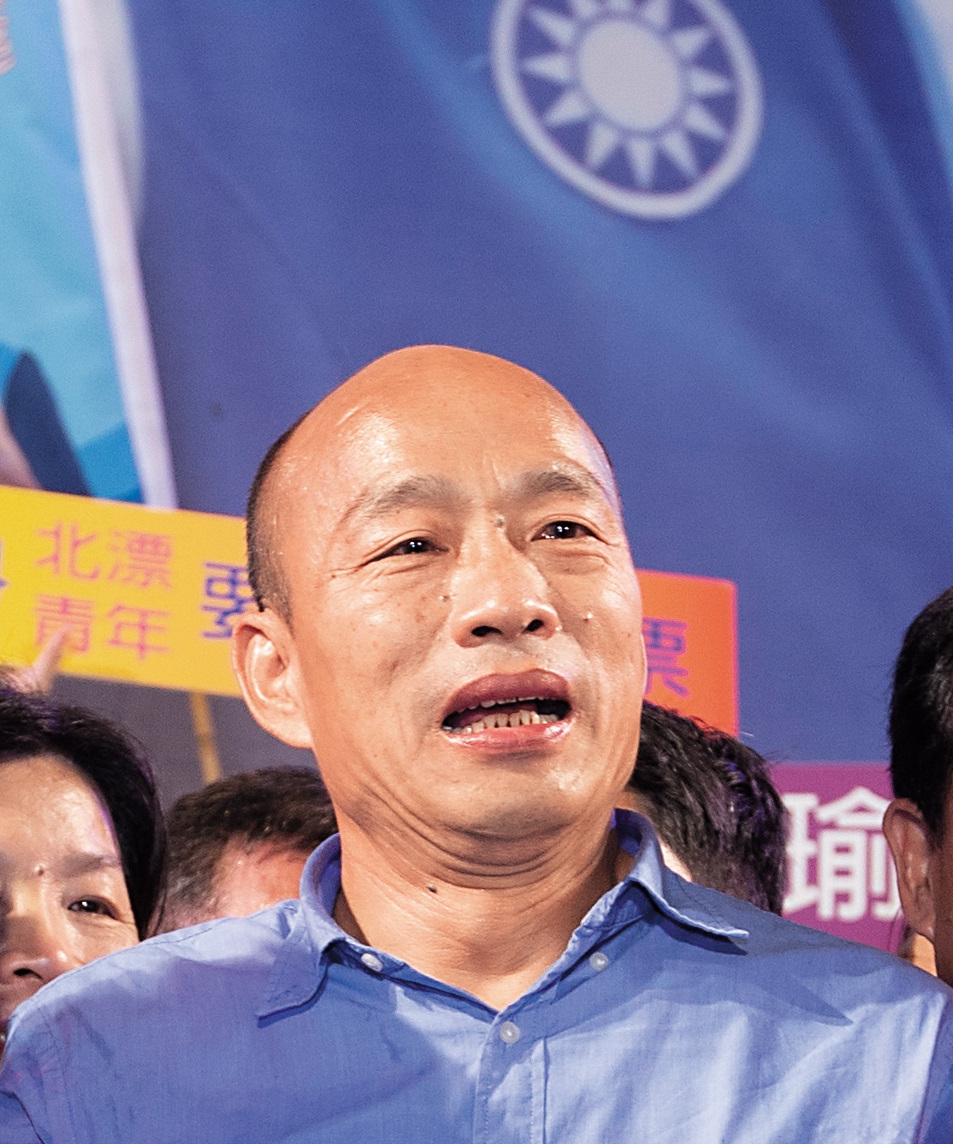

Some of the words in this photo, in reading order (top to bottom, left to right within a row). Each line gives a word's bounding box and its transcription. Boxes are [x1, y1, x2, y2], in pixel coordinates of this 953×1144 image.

[35, 521, 173, 589] 北漂
[34, 594, 172, 661] 青年
[783, 785, 902, 921] 瑜
